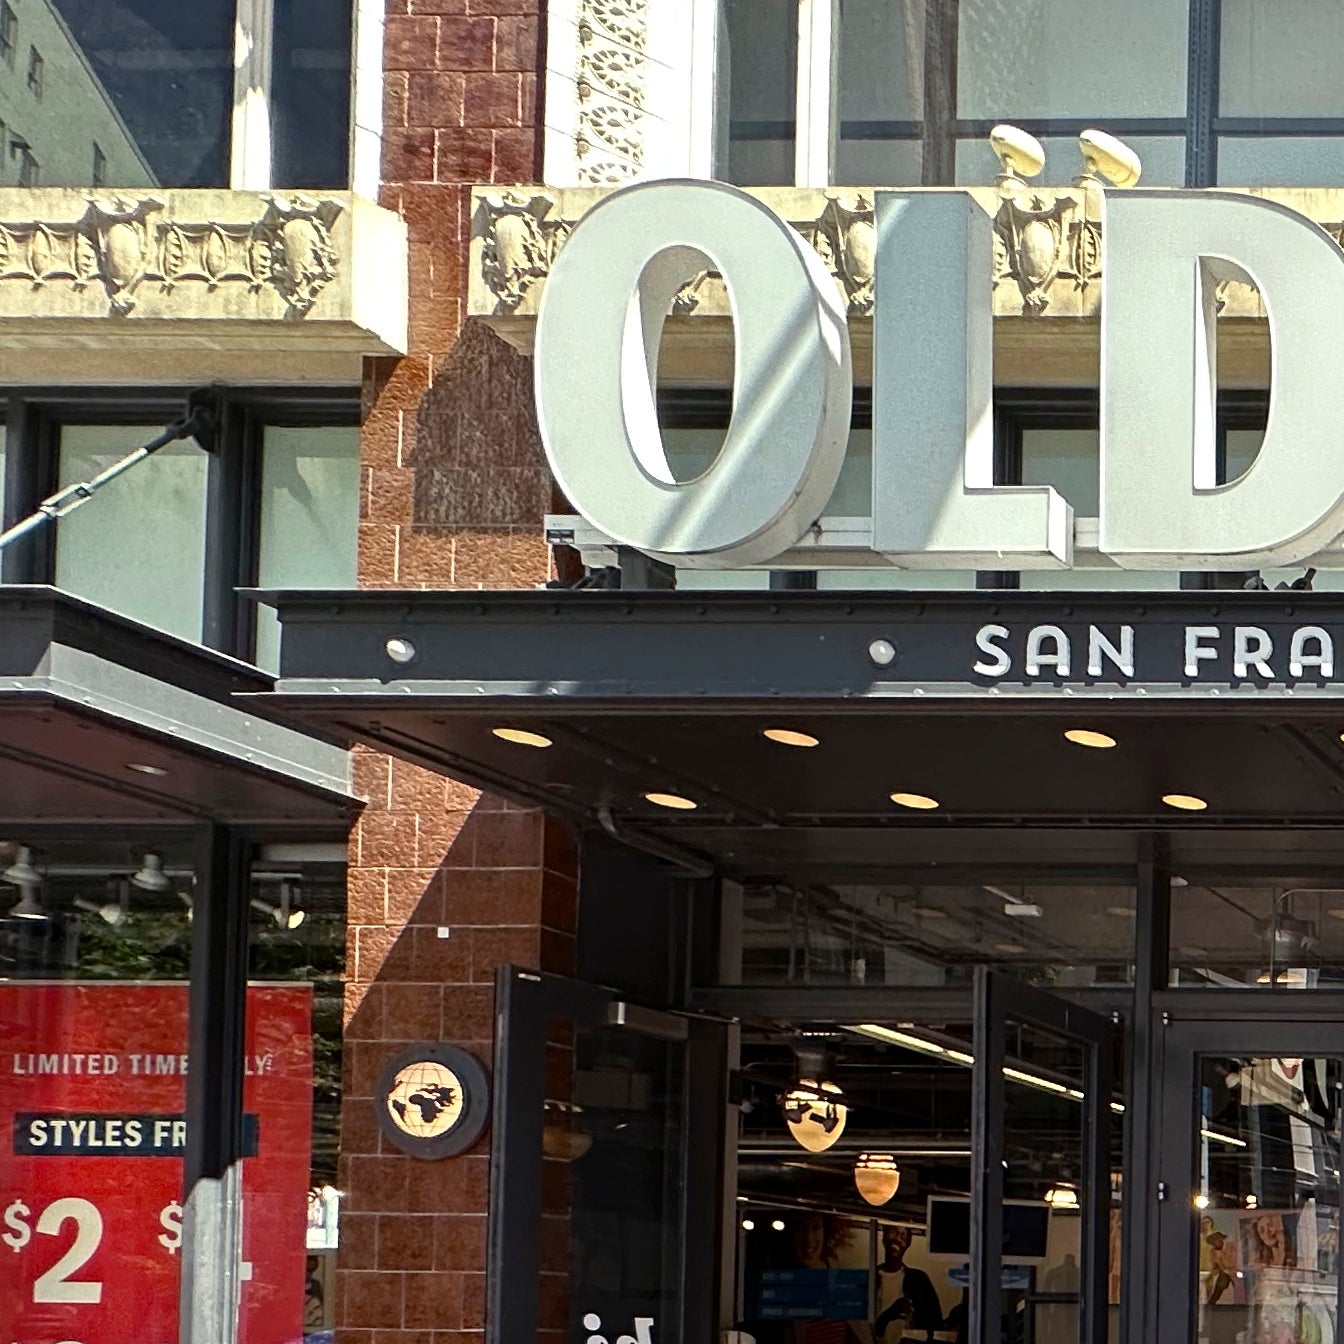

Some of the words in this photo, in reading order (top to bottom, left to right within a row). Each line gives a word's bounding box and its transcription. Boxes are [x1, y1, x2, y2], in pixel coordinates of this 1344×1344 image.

[972, 624, 1135, 678] SAN
[13, 1053, 119, 1075] LIMITED
[130, 1054, 189, 1075] TIME
[29, 1119, 143, 1147] STYLES
[153, 1121, 187, 1147] FR
[2, 1198, 104, 1304] $2
